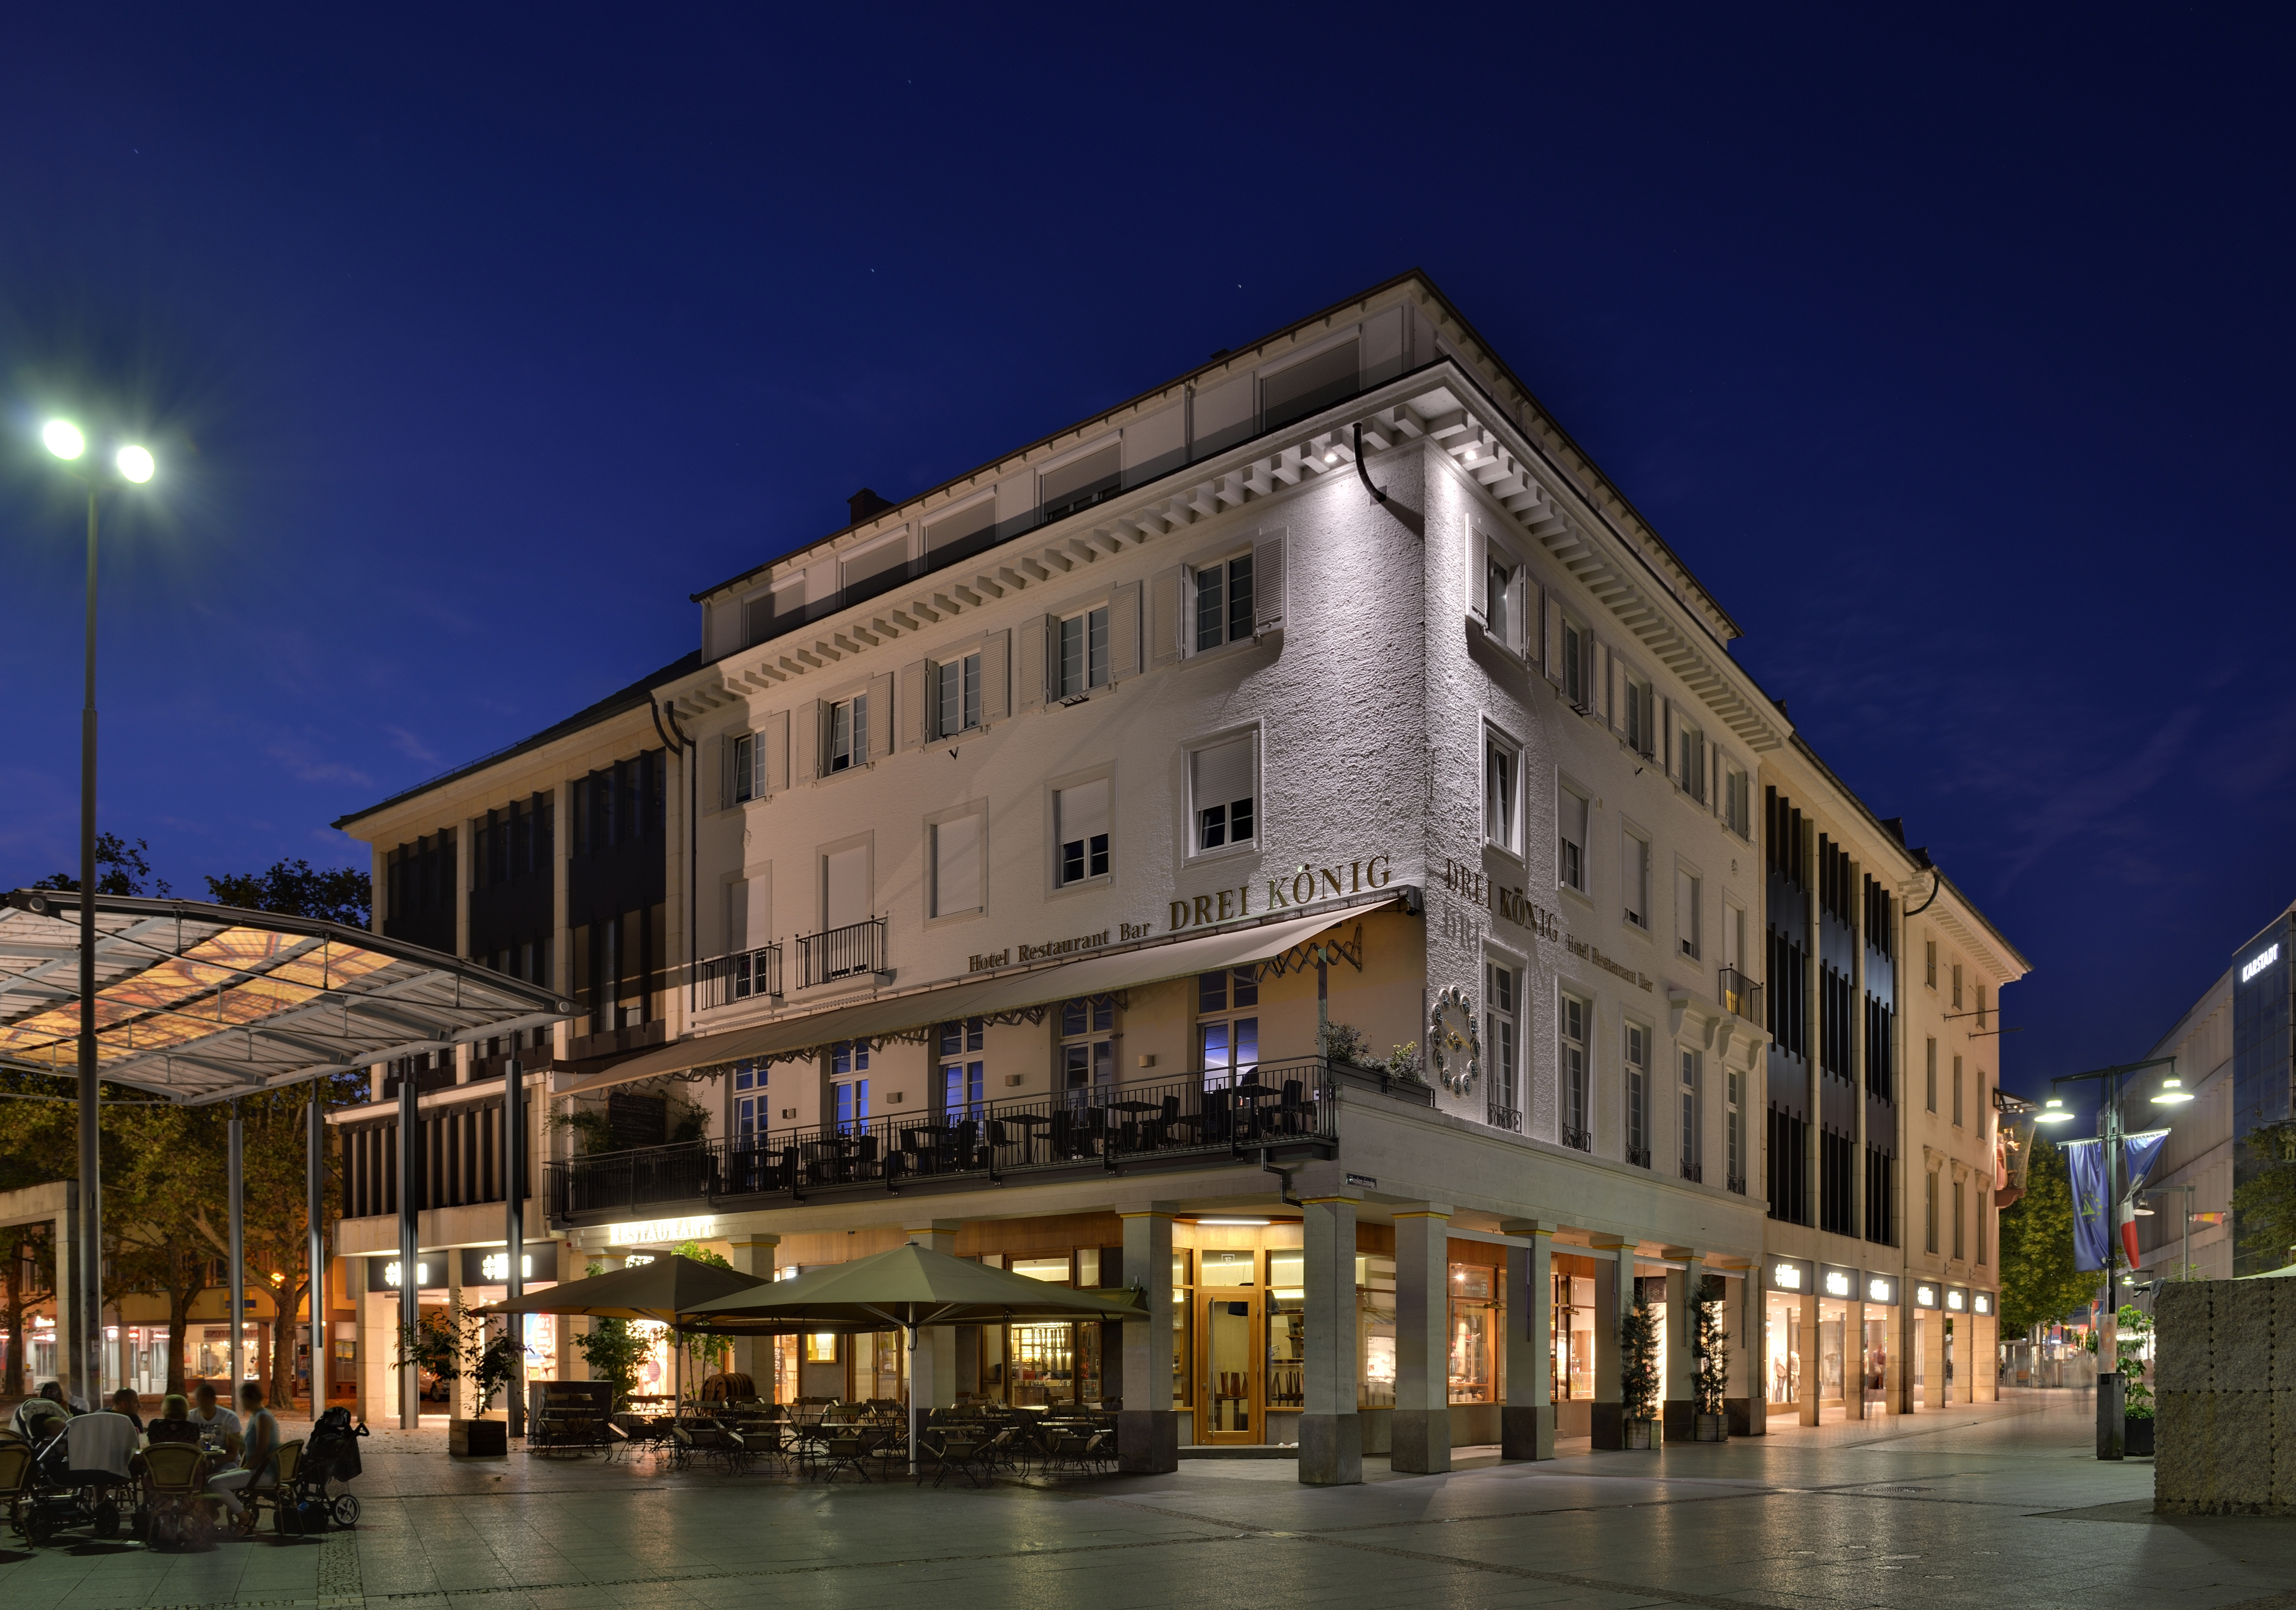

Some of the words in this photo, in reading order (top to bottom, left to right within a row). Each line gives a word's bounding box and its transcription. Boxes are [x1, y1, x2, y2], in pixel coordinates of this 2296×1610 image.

[969, 948, 1009, 973] Hotel
[1018, 928, 1108, 963] Restaurant
[1119, 923, 1150, 942] Bar
[1169, 886, 1249, 931] DREI
[1267, 854, 1392, 911] KÖNIG
[1446, 858, 1492, 911] DREI
[1500, 886, 1559, 942] KÖNIG
[1567, 933, 1589, 960] Hotel
[1592, 947, 1636, 985] Restaurant
[1639, 972, 1653, 993] Bar
[2243, 943, 2278, 982] KARSTADT
[610, 1217, 712, 1244] RESTAURANT
